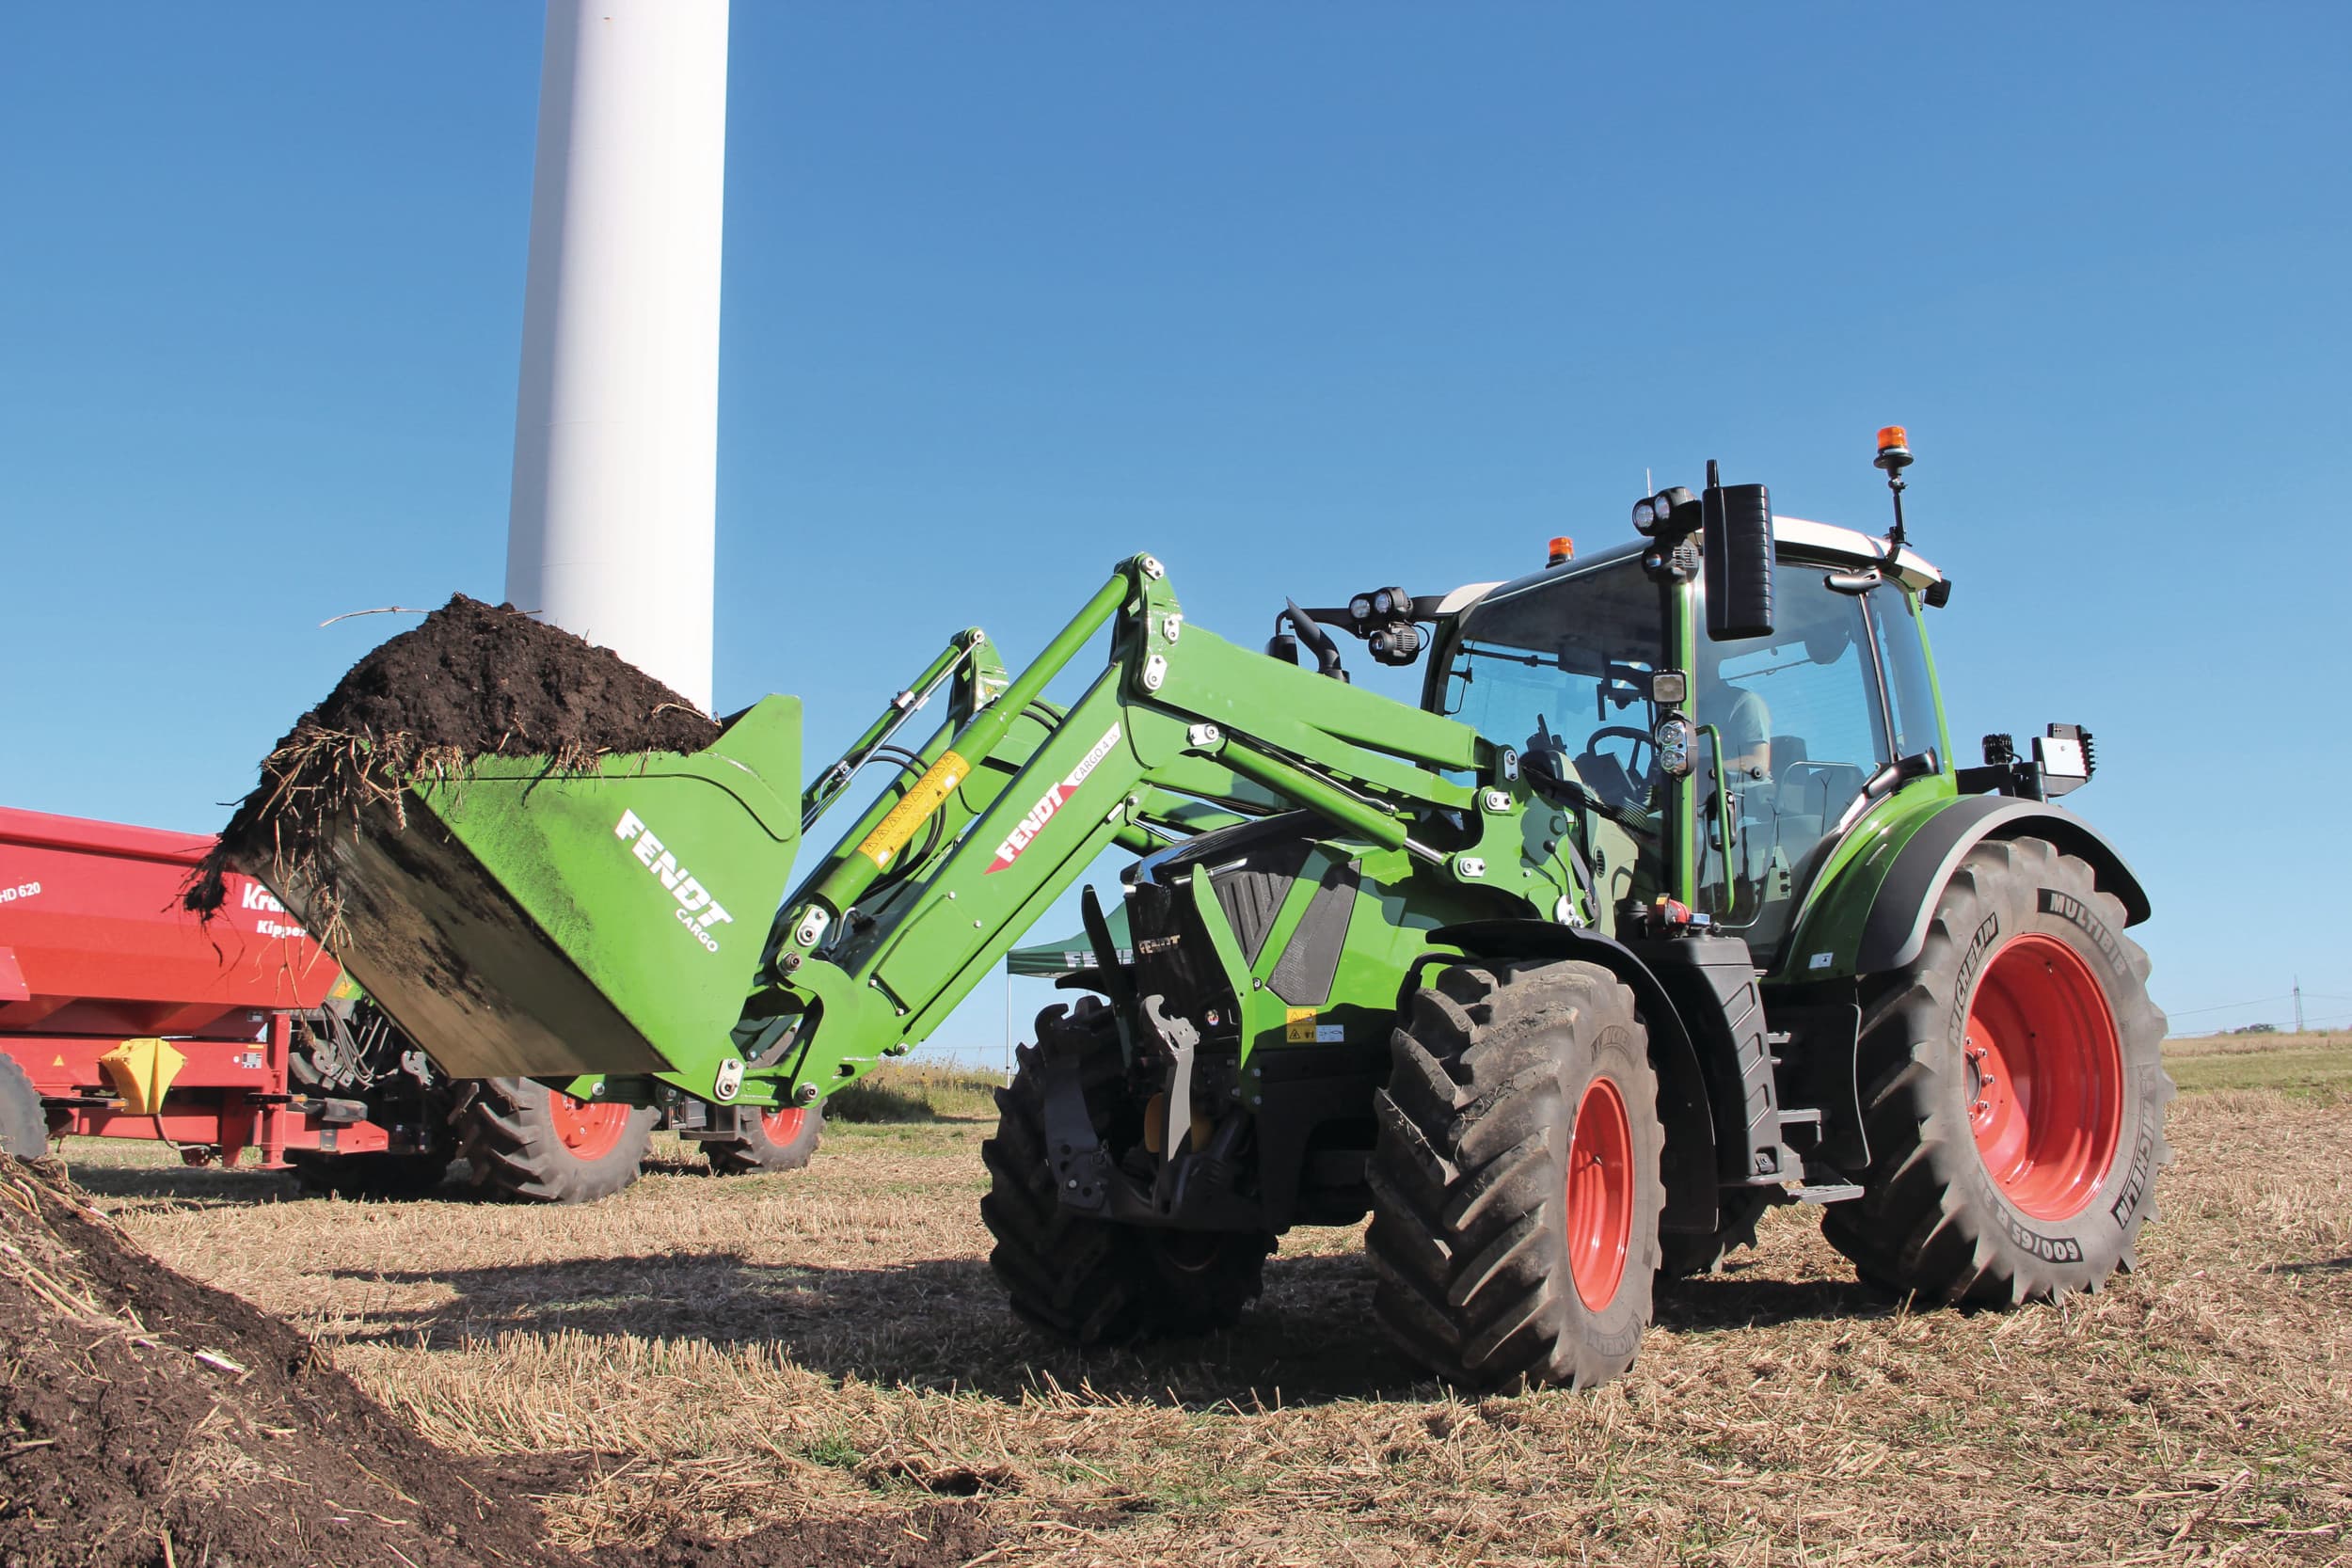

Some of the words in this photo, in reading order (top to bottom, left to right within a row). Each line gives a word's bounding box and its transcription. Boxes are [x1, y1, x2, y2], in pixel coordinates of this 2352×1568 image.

[995, 783, 1063, 863] FENDT
[1073, 748, 1104, 781] CARGO
[18, 881, 41, 897] 620
[242, 882, 286, 912] Kra
[614, 808, 734, 927] FENDT
[675, 908, 719, 953] CARGO
[2048, 892, 2127, 975] MULTIBIB
[1948, 912, 1998, 1047] MICHELIN
[2113, 1099, 2155, 1229] MICHELIN
[2011, 1222, 2081, 1261] 600/65
